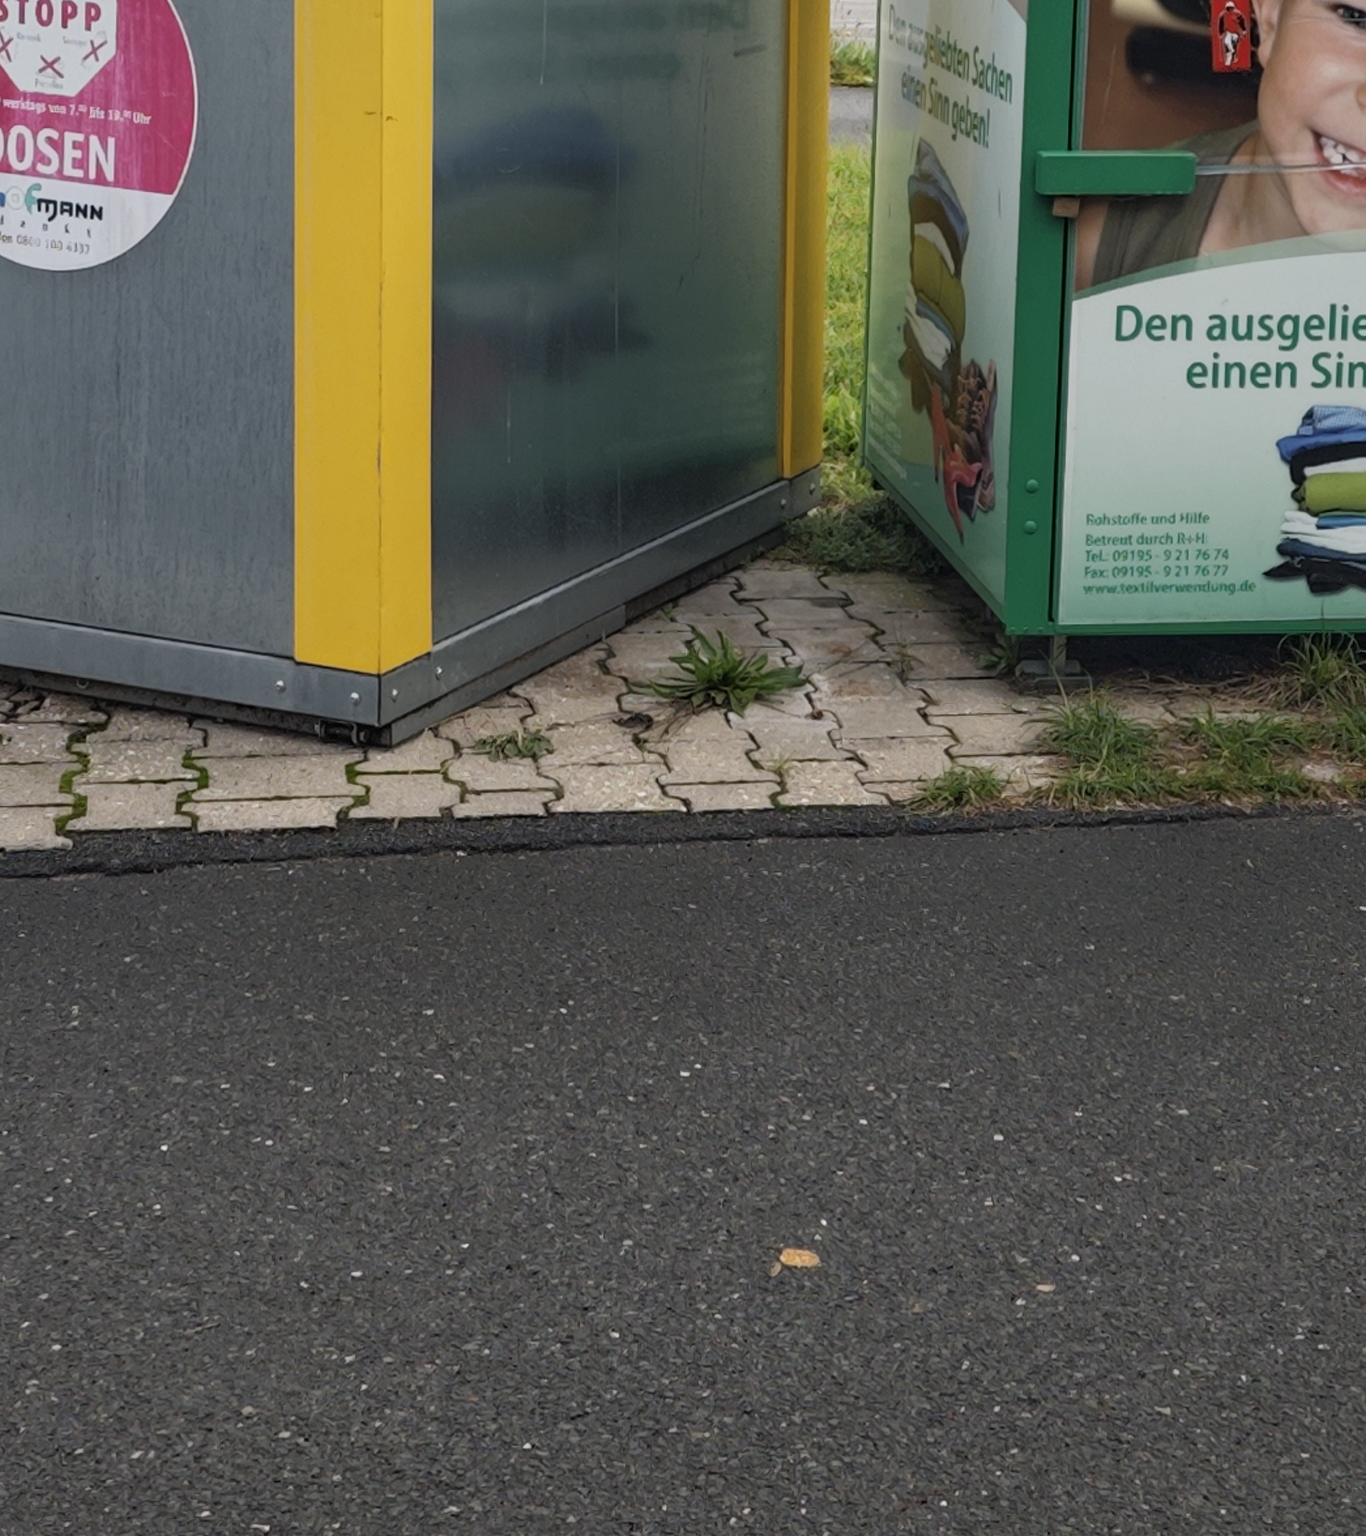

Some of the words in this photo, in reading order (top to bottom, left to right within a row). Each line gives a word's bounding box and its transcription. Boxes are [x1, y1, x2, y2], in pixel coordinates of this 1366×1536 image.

[971, 44, 1013, 105] Sachen
[928, 76, 950, 126] Sinn
[951, 94, 991, 149] geben!
[1115, 305, 1193, 341] Den
[1186, 352, 1297, 389] einen
[1086, 513, 1147, 526] Rohstoffe
[1151, 513, 1176, 524] und
[1180, 512, 1210, 524] Hilfe
[1086, 534, 1133, 546] Betreut
[1136, 533, 1174, 545] durch
